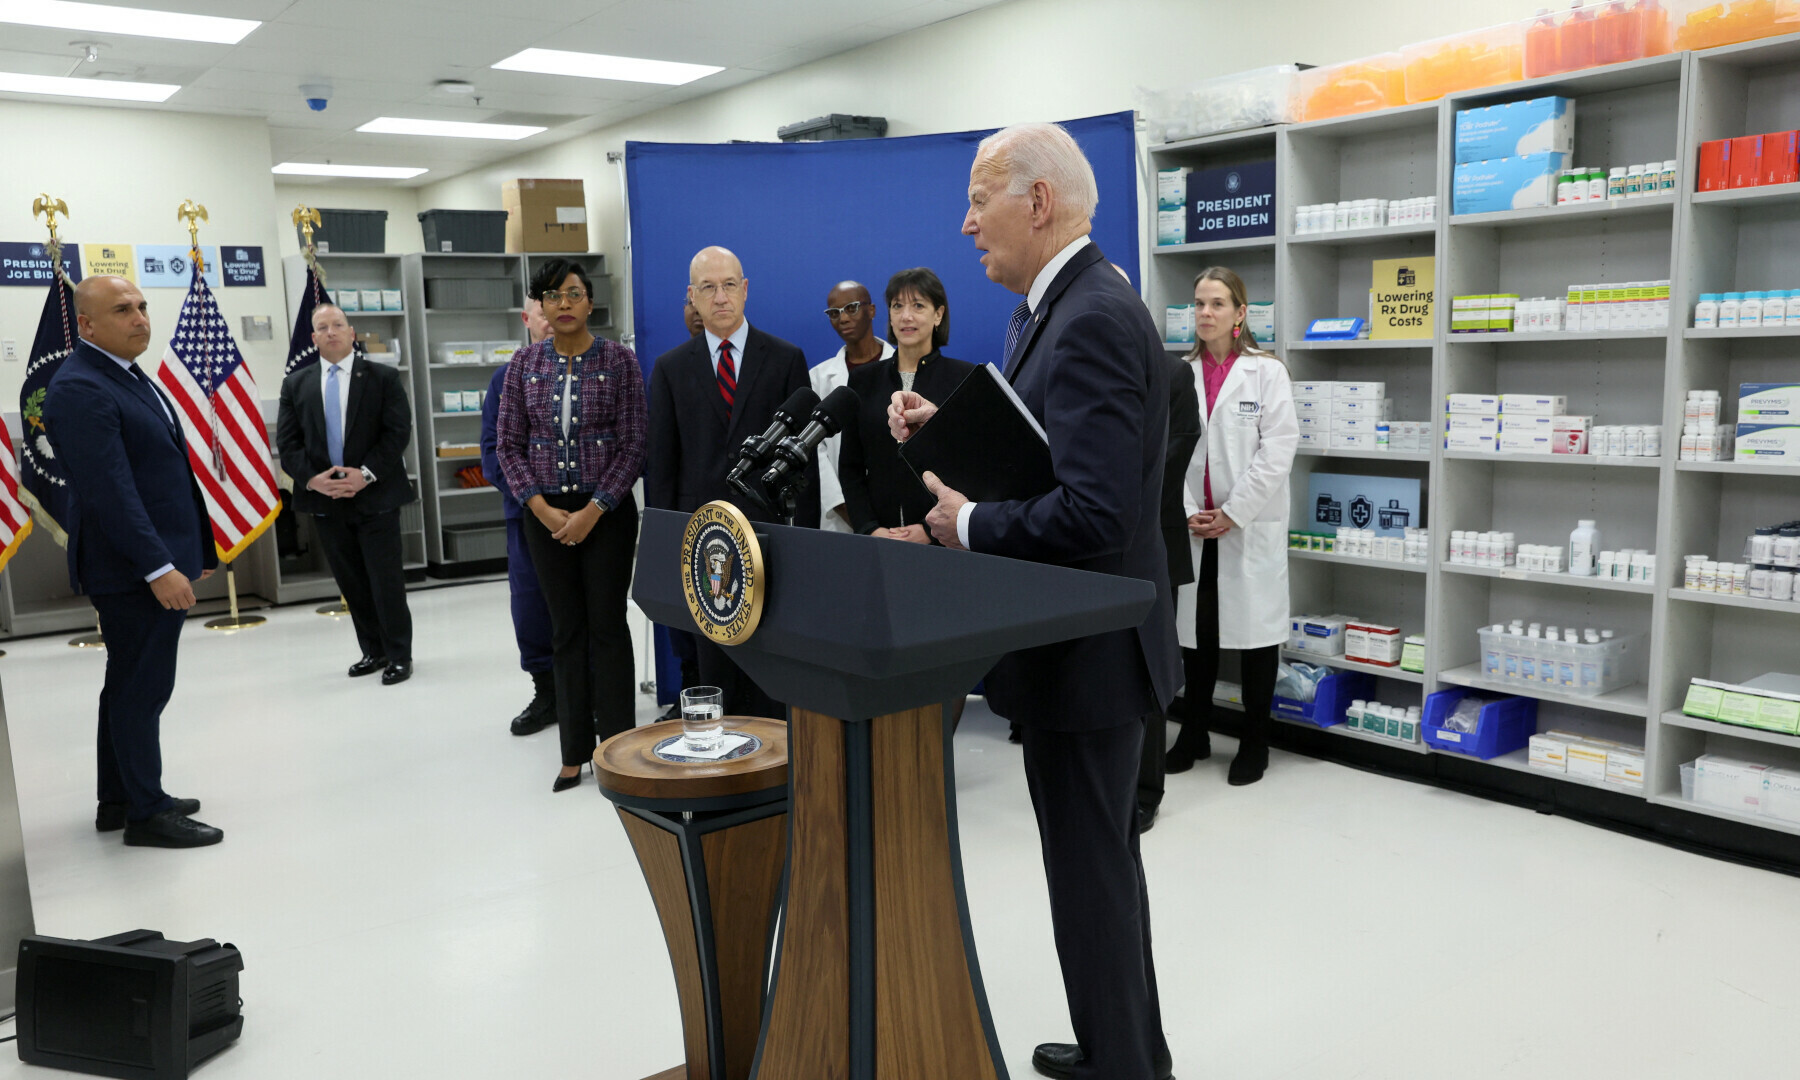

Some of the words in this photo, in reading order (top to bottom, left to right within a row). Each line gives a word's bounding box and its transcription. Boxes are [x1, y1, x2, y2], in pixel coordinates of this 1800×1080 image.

[1197, 194, 1271, 213] PRESIDENT
[1199, 217, 1223, 230] JOE
[1227, 213, 1268, 227] BIDEN
[3, 258, 71, 268] PRESIDT
[89, 261, 129, 269] Lowering
[224, 261, 260, 269] Lowering
[7, 270, 31, 279] JOE
[34, 270, 70, 279] BID
[107, 267, 127, 275] Drug
[239, 268, 258, 276] Drug
[1377, 290, 1433, 303] Lowering
[1381, 305, 1396, 315] Rx
[1400, 304, 1428, 316] Drug
[1389, 316, 1422, 327] Costs
[1240, 403, 1254, 411] NIH
[715, 511, 723, 520] OF
[724, 515, 735, 529] THE
[683, 509, 714, 566] PRESIDENT
[735, 528, 754, 587] UNITED
[689, 592, 695, 603] OF
[694, 604, 714, 635] SEAL
[726, 600, 751, 638] STATES
